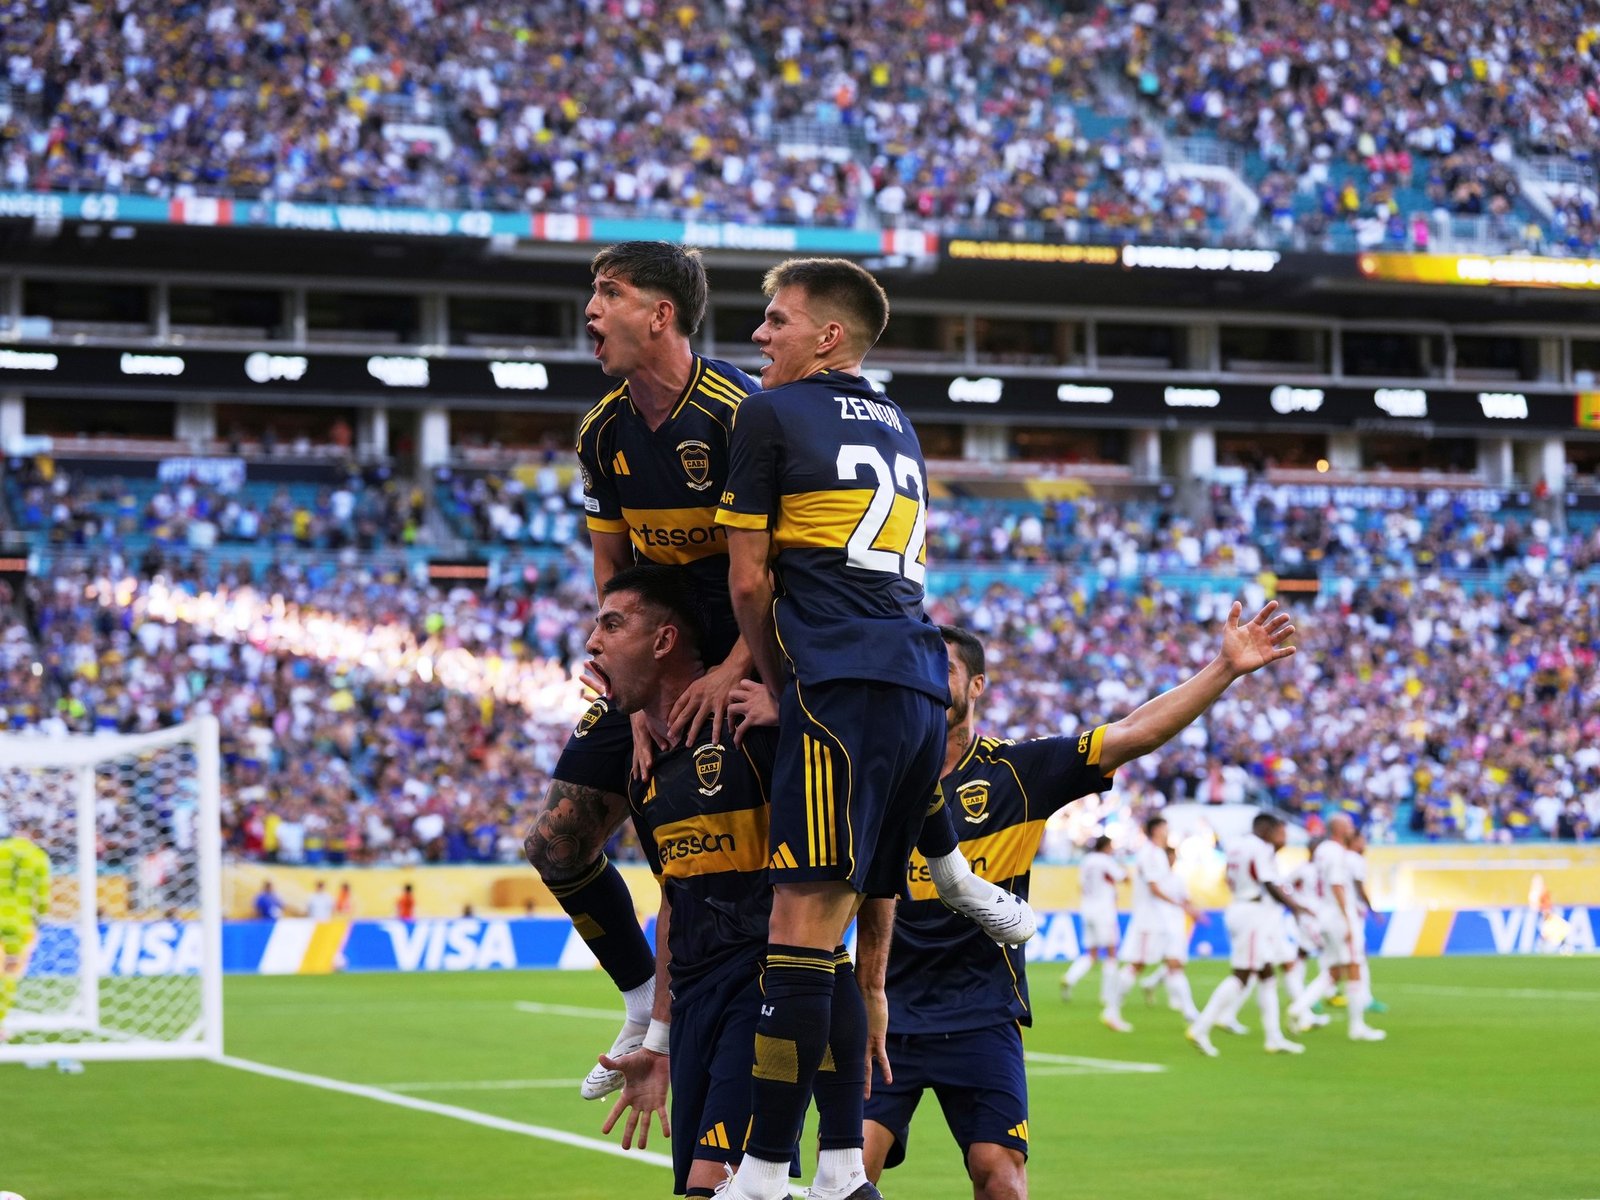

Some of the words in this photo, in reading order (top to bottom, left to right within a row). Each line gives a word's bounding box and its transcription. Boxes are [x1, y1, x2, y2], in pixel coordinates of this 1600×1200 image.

[833, 396, 904, 434] ZENON
[686, 460, 706, 469] CABJ
[836, 444, 927, 586] 22
[632, 523, 728, 547] tsson
[700, 763, 719, 773] CABJ
[965, 796, 984, 805] CABJ
[378, 920, 519, 971] VISA
